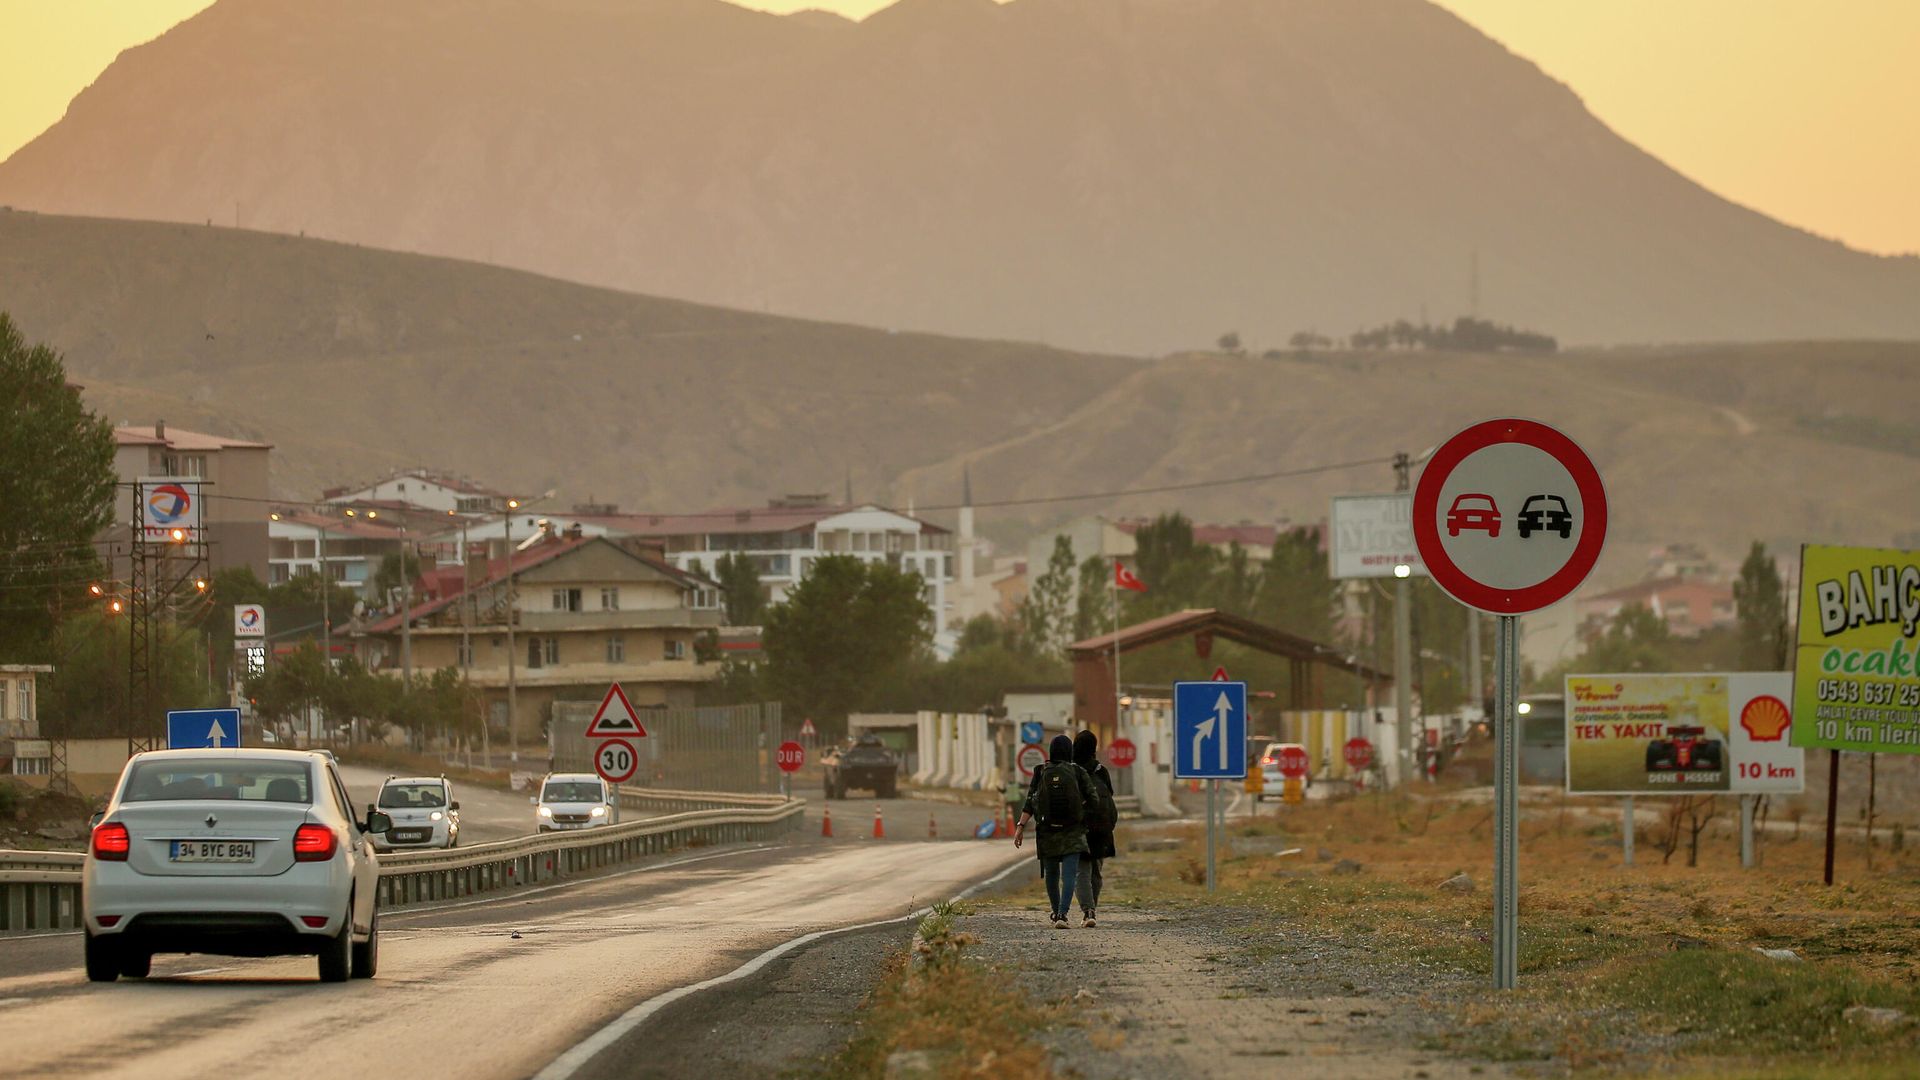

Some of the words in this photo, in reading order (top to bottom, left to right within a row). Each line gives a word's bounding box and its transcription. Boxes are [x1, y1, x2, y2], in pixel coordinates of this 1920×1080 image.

[1817, 565, 1920, 638] BAHÇ
[1818, 680, 1860, 702] 0543
[1864, 682, 1896, 705] 637
[1816, 705, 1847, 719] AHLAT
[1575, 724, 1606, 739] TEK
[1816, 720, 1838, 740] 10
[1844, 721, 1873, 743] km
[777, 750, 802, 763] DUR
[1109, 746, 1134, 759] DUR
[603, 751, 629, 771] 30
[1738, 763, 1762, 778] 10
[1768, 763, 1796, 778] km
[180, 844, 195, 857] 34
[201, 844, 224, 857] BYC
[229, 844, 251, 858] 894
